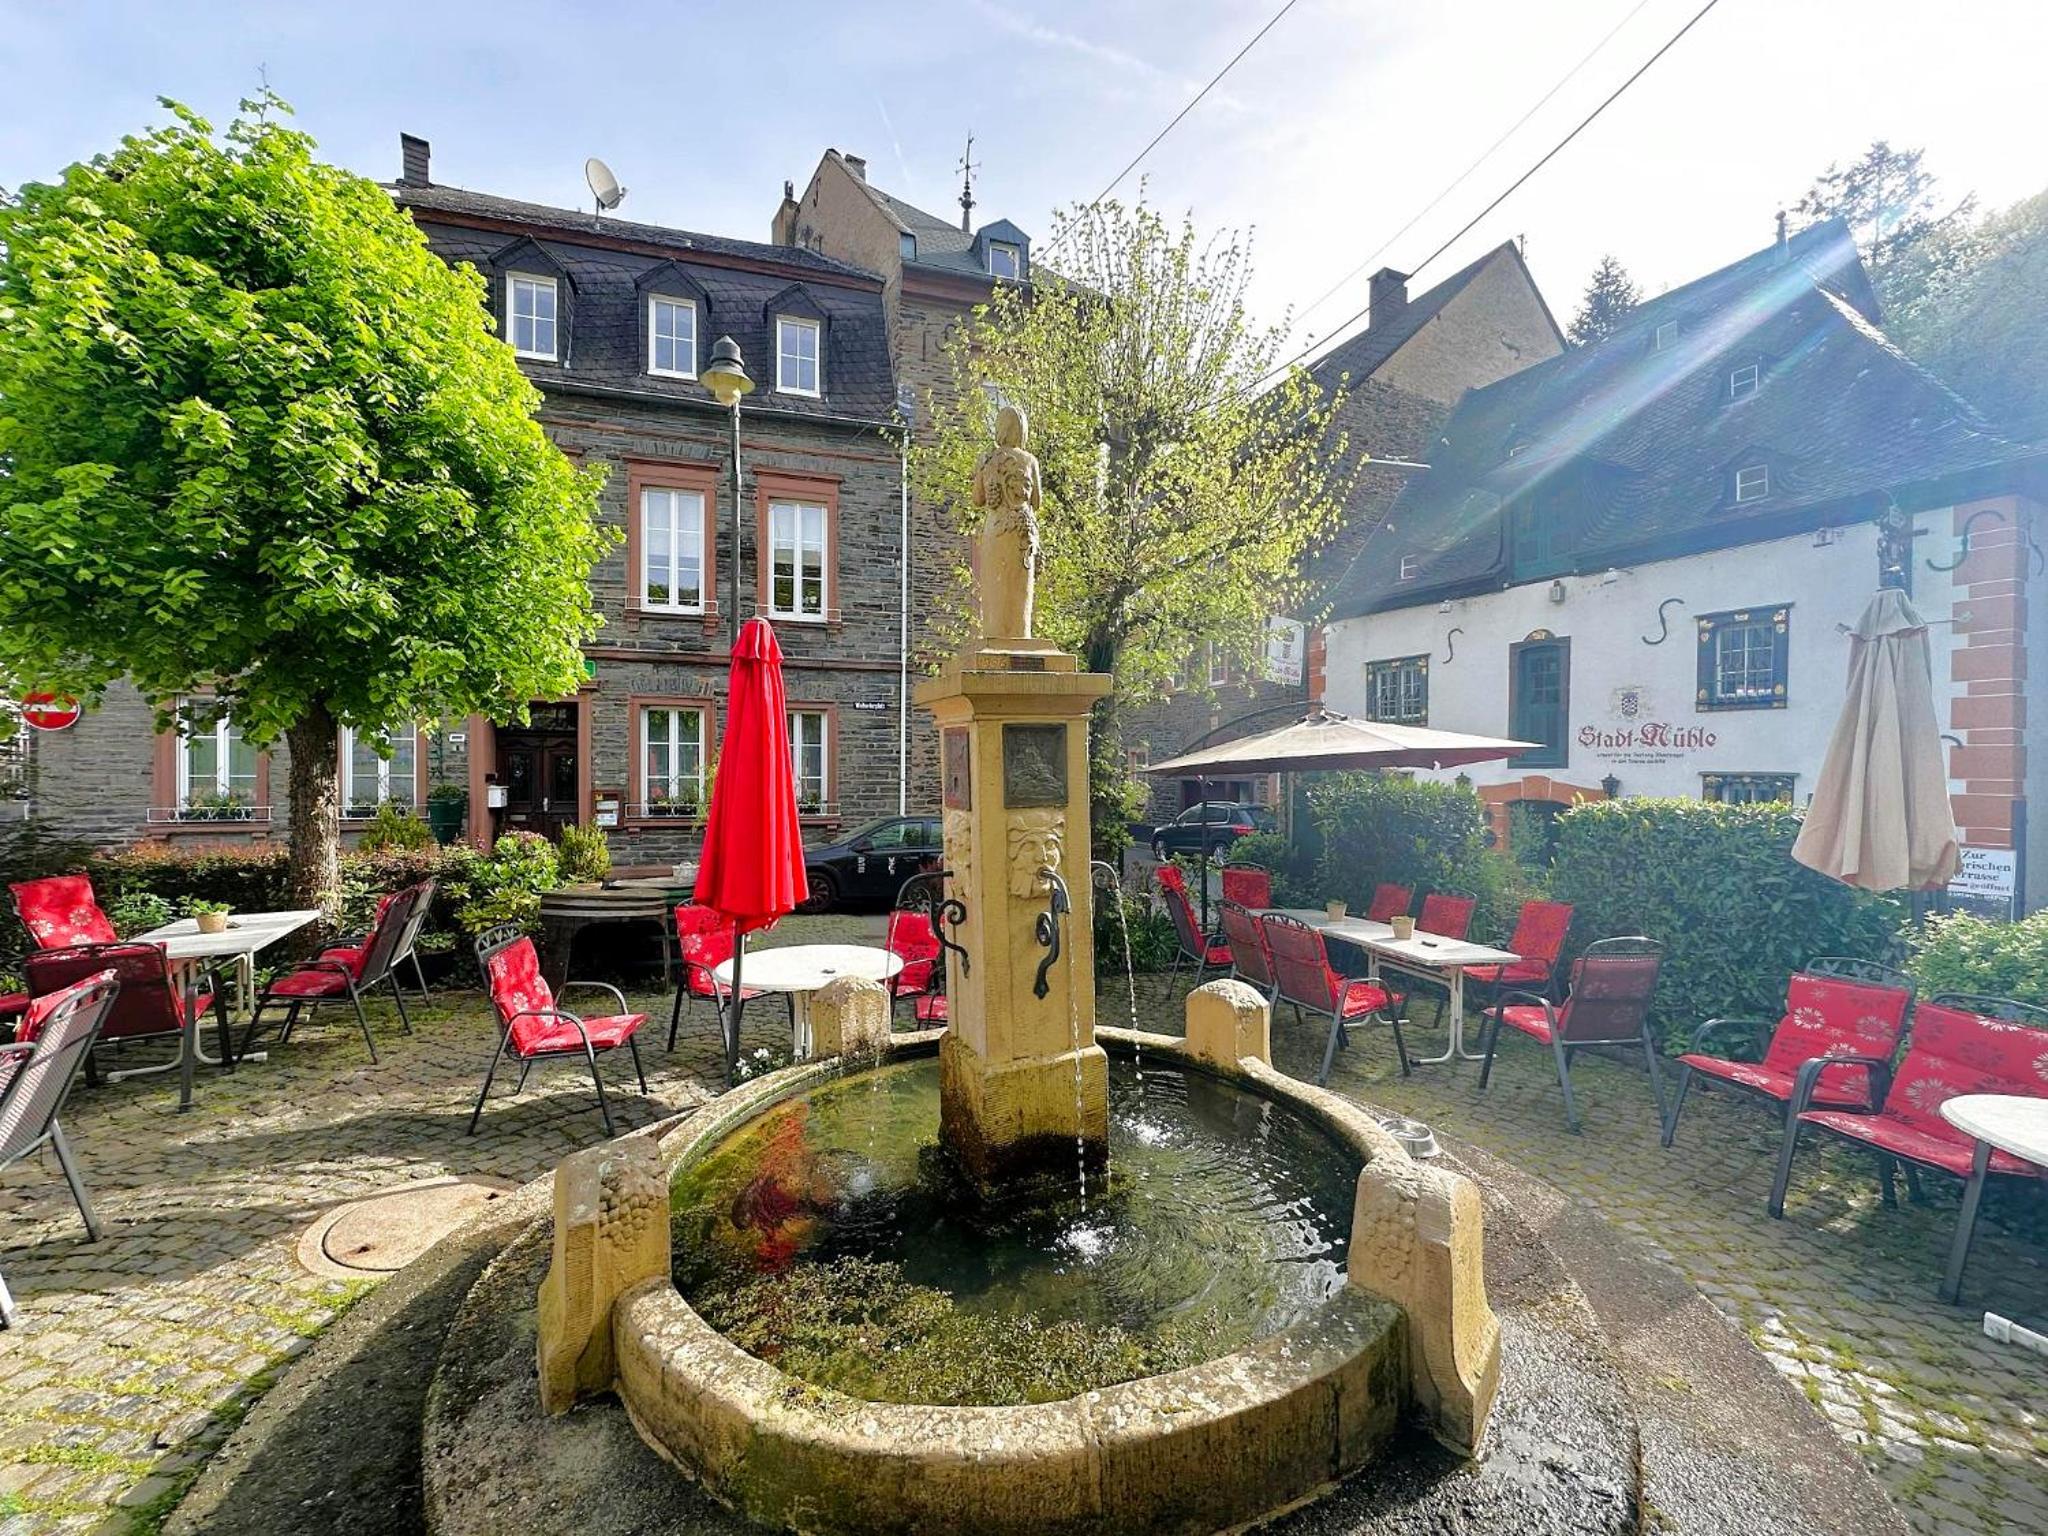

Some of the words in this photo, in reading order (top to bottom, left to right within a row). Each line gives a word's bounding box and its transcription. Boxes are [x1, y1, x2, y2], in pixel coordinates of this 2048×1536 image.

[1578, 723, 1717, 752] Stadt-Mühle
[1962, 851, 1986, 860] Zur
[1962, 861, 2011, 872] rischen
[1959, 872, 2000, 882] rrasse
